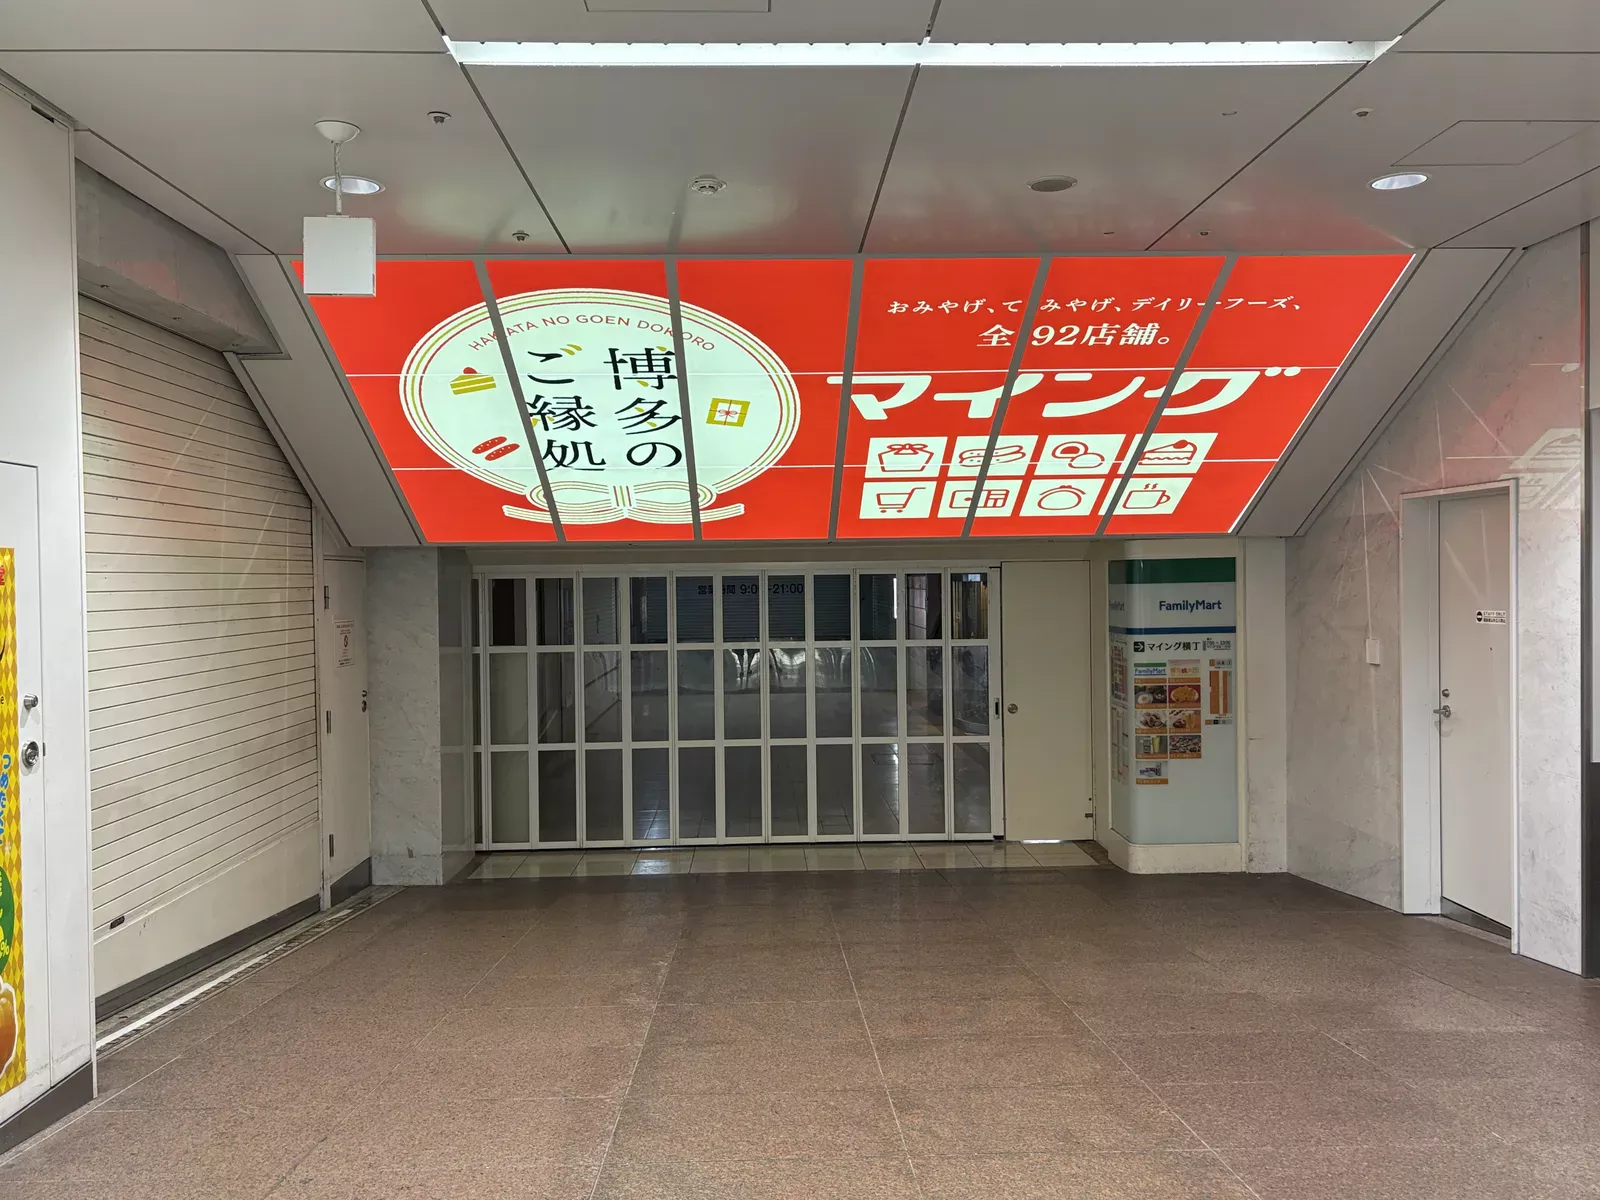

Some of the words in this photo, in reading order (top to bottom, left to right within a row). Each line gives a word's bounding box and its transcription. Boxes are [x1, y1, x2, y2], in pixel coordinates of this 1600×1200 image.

[468, 319, 539, 351] HAKATA
[541, 315, 570, 326] NO
[576, 315, 630, 327] GOEN
[637, 320, 715, 351] DOKORO
[526, 343, 606, 472] ご縁処
[603, 346, 683, 470] 博多の
[826, 365, 1301, 420] マイング
[1159, 600, 1222, 613] FamilyMart
[1147, 641, 1201, 651] マイング横丁
[1134, 667, 1166, 676] FamilyMart
